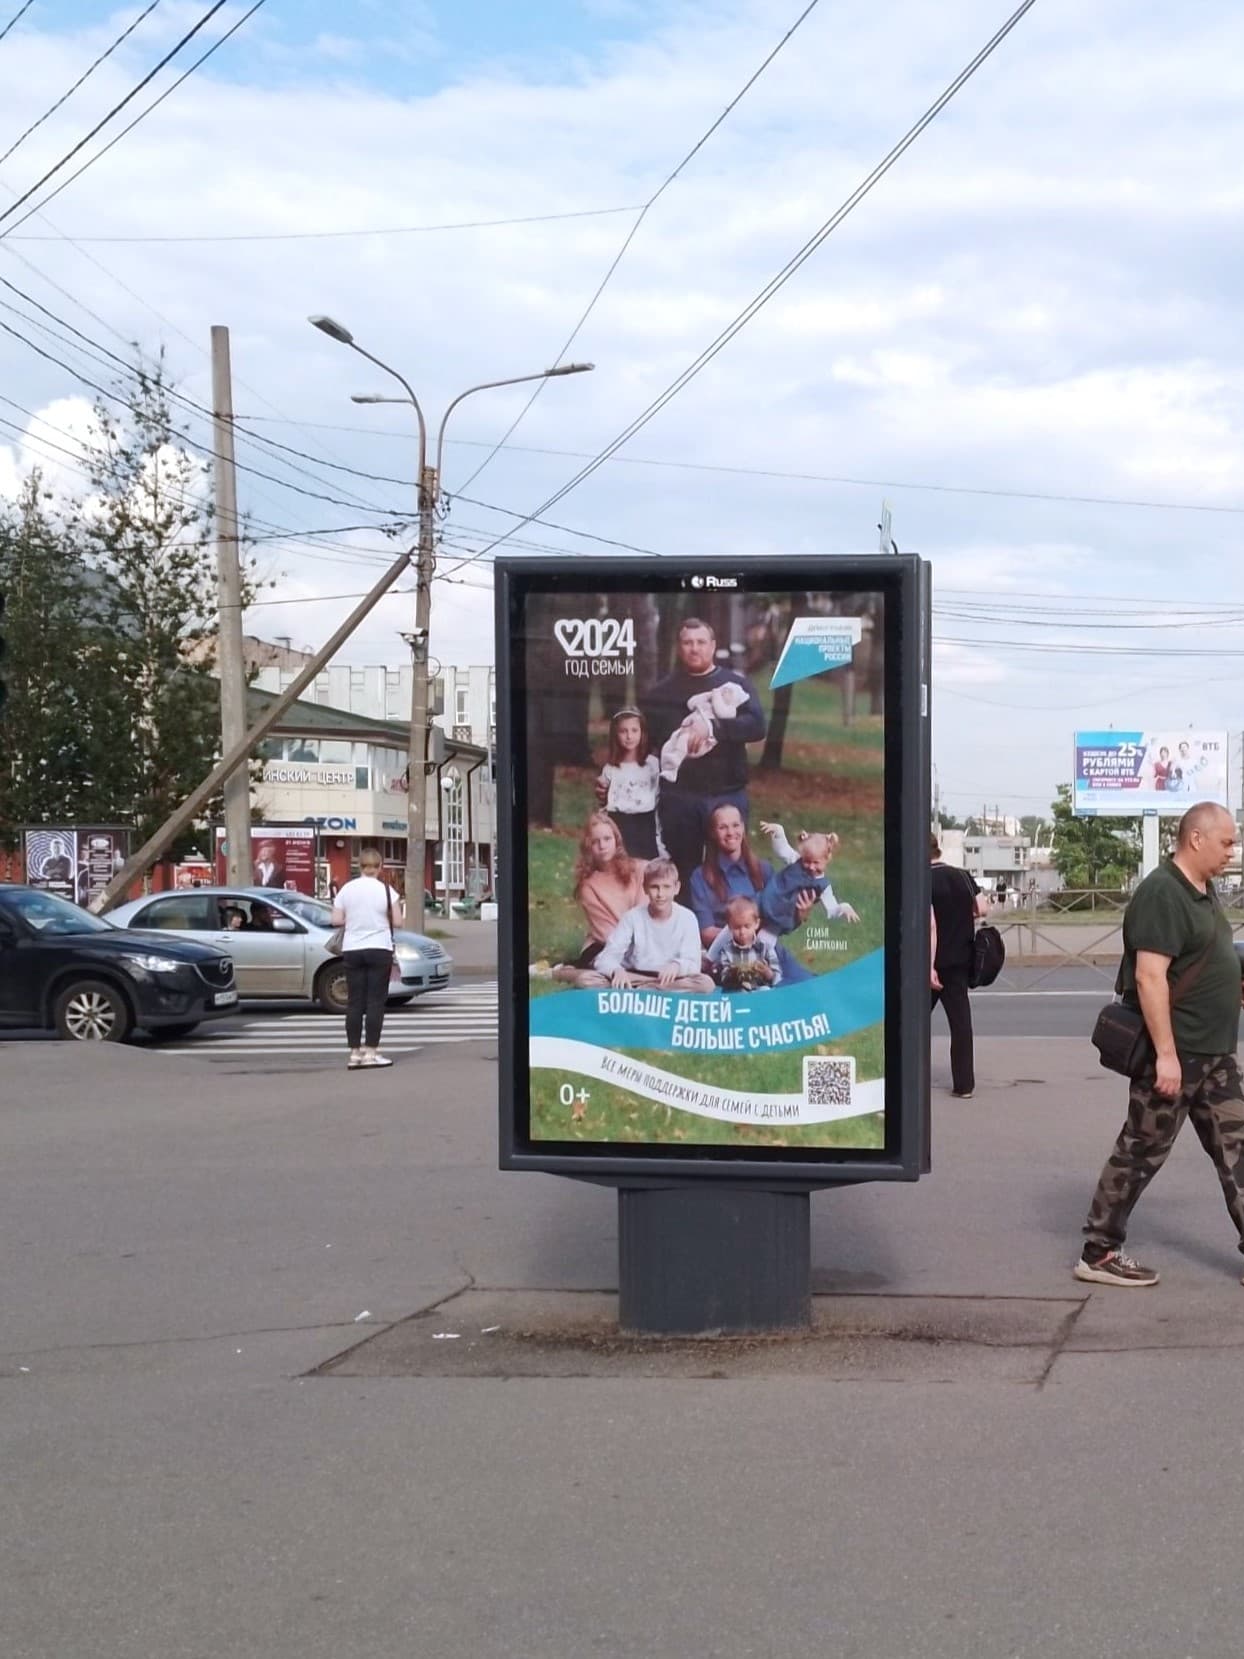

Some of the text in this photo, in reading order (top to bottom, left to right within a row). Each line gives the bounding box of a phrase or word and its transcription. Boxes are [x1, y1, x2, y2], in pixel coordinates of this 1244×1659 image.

[706, 576, 738, 588] Russ
[554, 619, 637, 657] 2024
[794, 635, 852, 645] НАЦИОНАЛЬНЫЕ
[818, 645, 852, 653] ПРОЕКТЫ
[824, 653, 852, 662] РОССИИ
[1082, 757, 1135, 767] РУБЛЯМИ
[262, 766, 355, 785] ИНСКИЙ ЦЕНТР
[598, 991, 673, 1019] БОЛЬШЕ
[674, 997, 732, 1024] ДЕТЕЙ
[671, 1013, 831, 1050] БОЛЬШЕ СЧАСТЬЯ!
[559, 1083, 591, 1105] 0+
[600, 1055, 616, 1073] ВСЕ
[617, 1063, 642, 1084] МЕРЫ
[643, 1075, 699, 1103] ПОДДЕРЖКИ
[699, 1093, 720, 1109] ДЛЯ
[721, 1096, 751, 1115] СЕМЕЙ
[761, 1104, 801, 1119] ДЕТЬМИ
